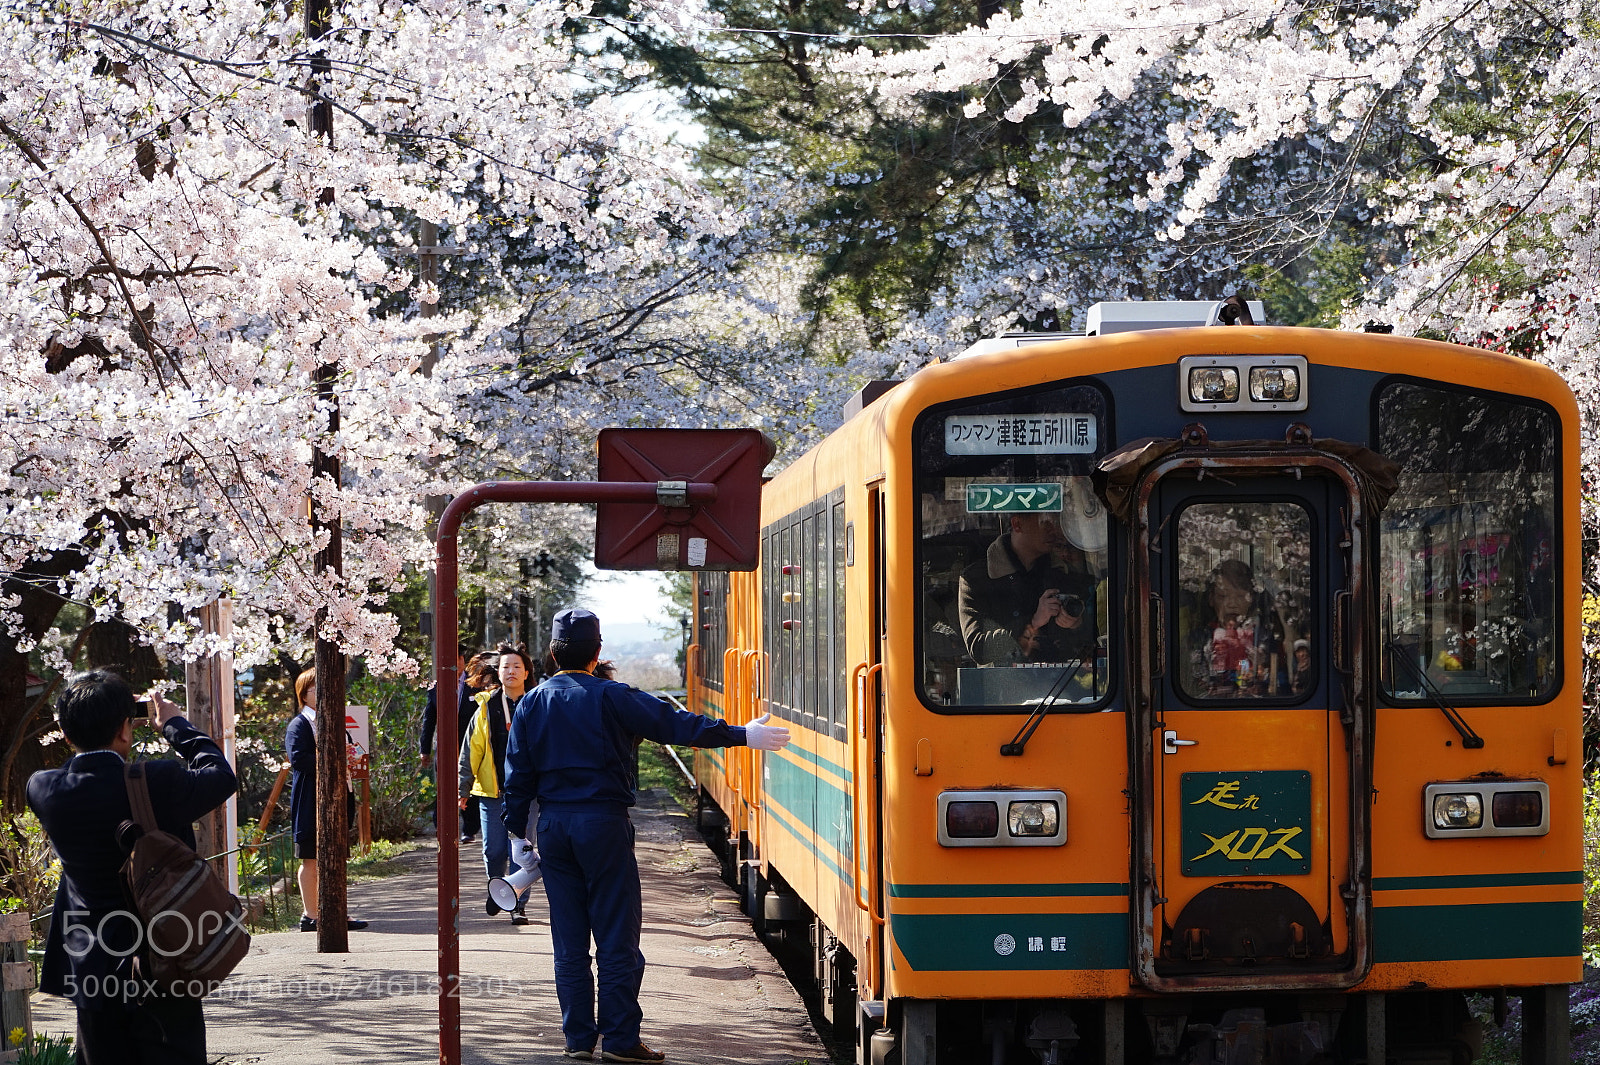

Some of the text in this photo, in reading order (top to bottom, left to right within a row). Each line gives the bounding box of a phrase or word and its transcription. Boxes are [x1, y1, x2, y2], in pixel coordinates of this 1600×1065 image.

[970, 488, 1059, 509] ワンマン
[1189, 780, 1260, 810] 走れ
[1189, 826, 1303, 861] メロス
